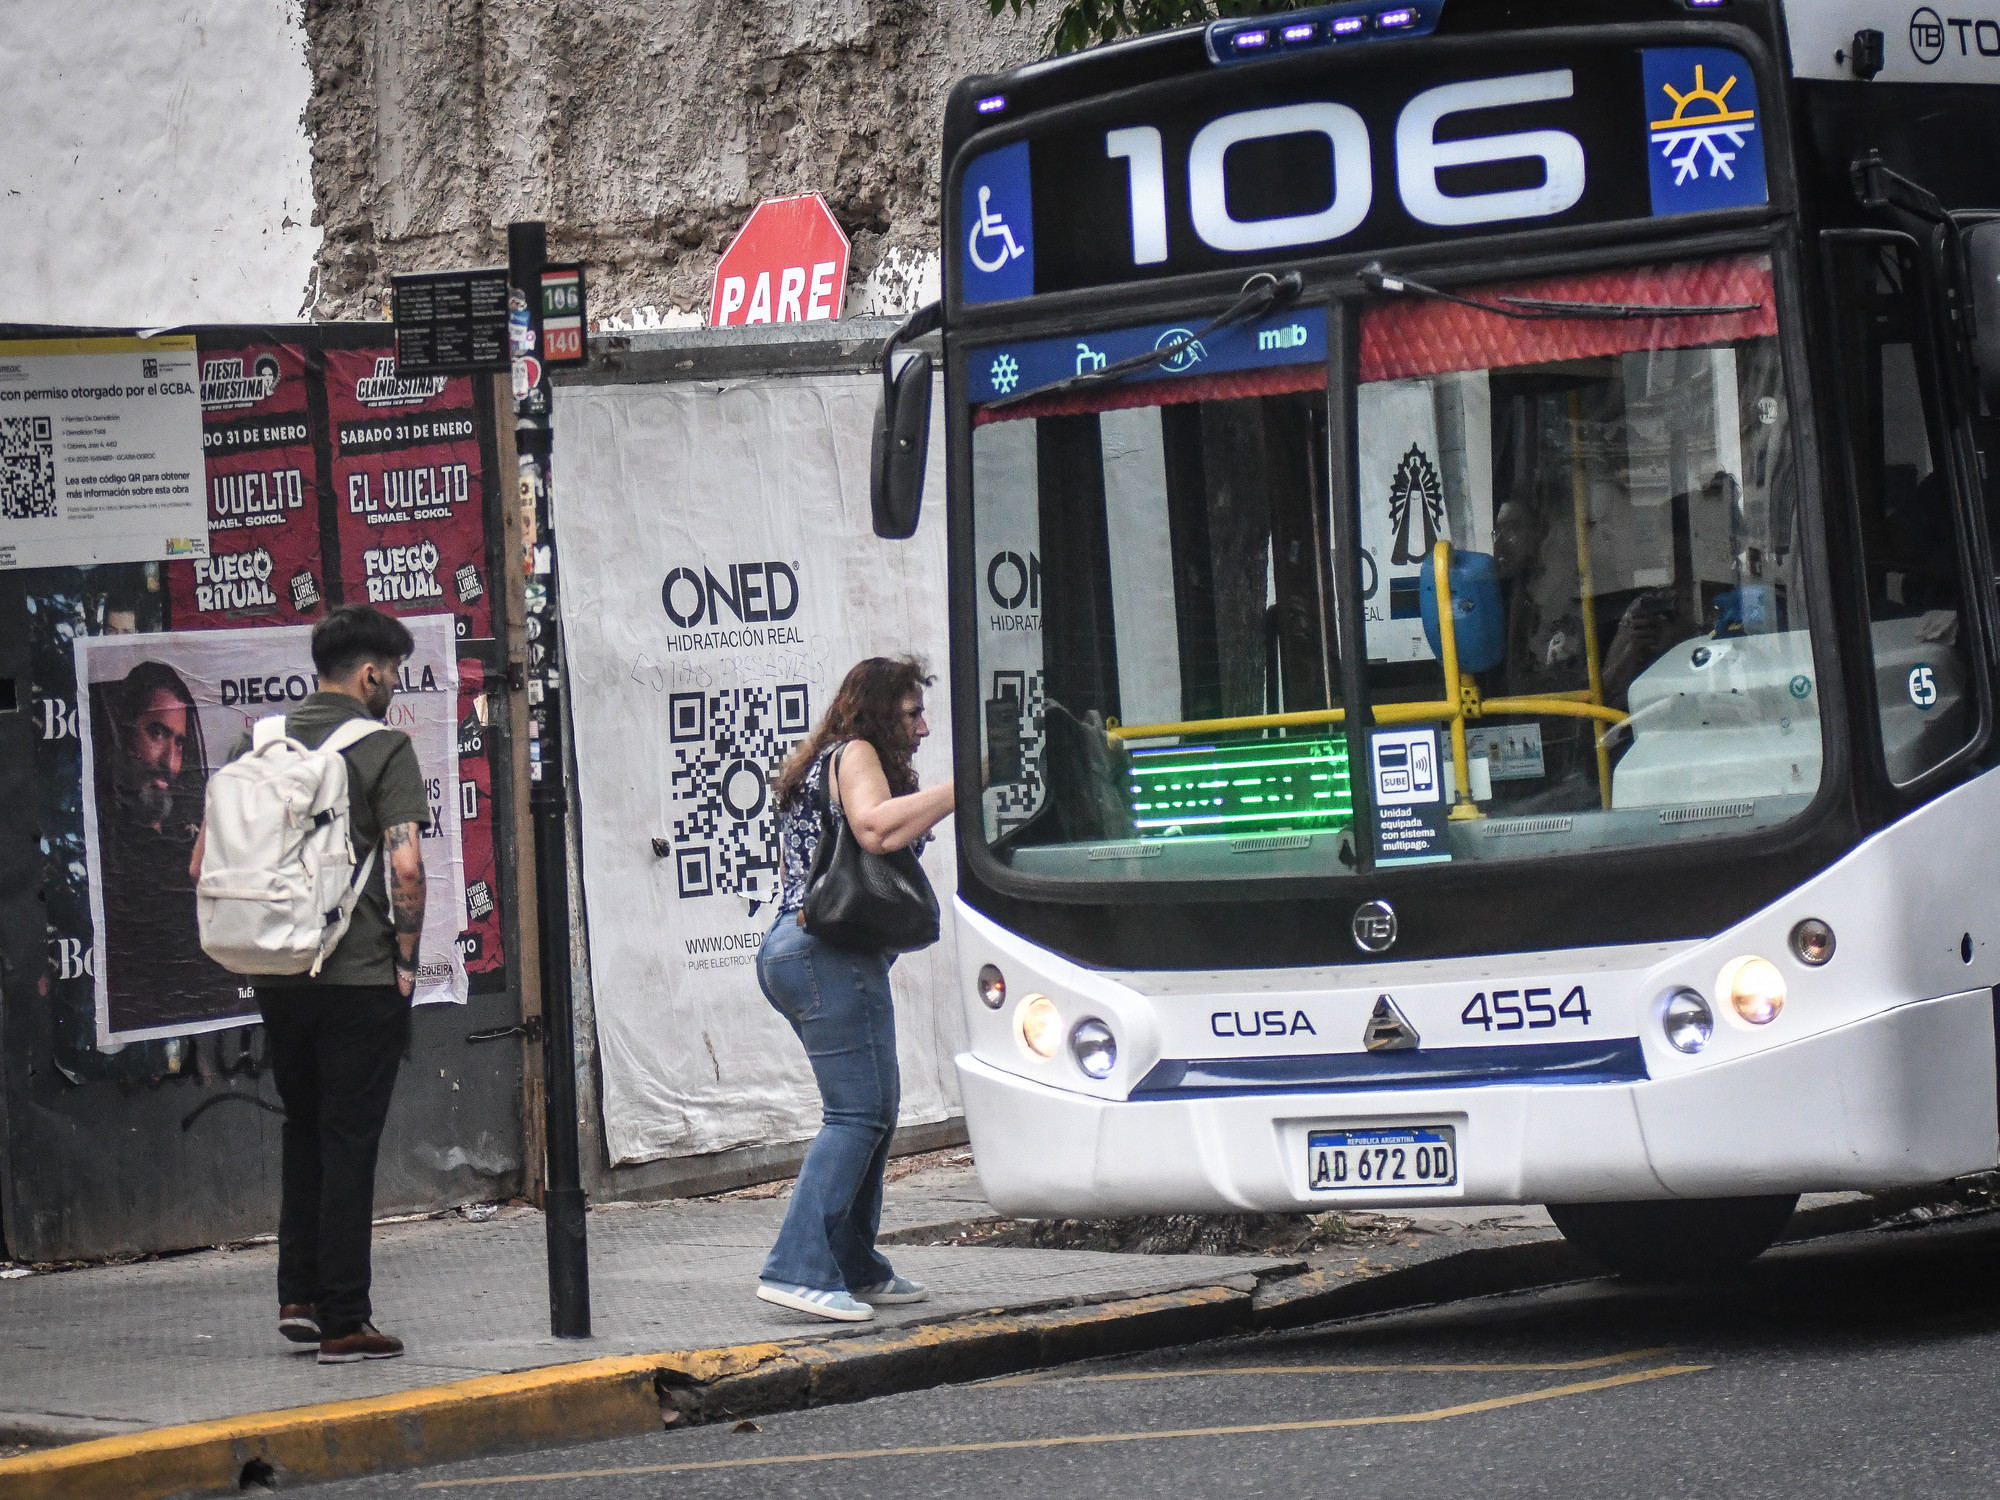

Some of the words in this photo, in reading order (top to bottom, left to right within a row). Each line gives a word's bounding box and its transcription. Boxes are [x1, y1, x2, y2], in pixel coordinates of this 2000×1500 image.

[1947, 18, 2000, 56] TO
[1107, 68, 1586, 265] 106
[545, 286, 579, 310] 106
[718, 261, 837, 326] PARE
[547, 330, 580, 353] 140
[205, 359, 242, 381] FIESTA
[375, 358, 395, 378] FIE
[1, 390, 21, 400] con
[24, 386, 69, 403] permiso
[71, 385, 123, 400] otorgado
[126, 386, 145, 399] por
[147, 383, 157, 395] el
[160, 382, 195, 395] GCBA.
[201, 379, 264, 401] ANDESTINA
[357, 378, 434, 399] CLANDESTINA
[204, 432, 222, 446] DO
[227, 430, 240, 443] 31
[244, 428, 259, 442] DE
[264, 425, 307, 441] ENERO
[341, 427, 392, 445] SABADO
[396, 425, 409, 439] 31
[413, 424, 429, 438] DE
[433, 421, 472, 437] ENERO
[66, 476, 79, 485] Lea
[81, 476, 97, 484] este
[100, 474, 127, 485] código
[128, 473, 140, 483] QR
[142, 474, 159, 483] para
[161, 472, 190, 481] obtener
[349, 475, 378, 513] EL
[383, 464, 468, 509] VUELTO
[66, 489, 82, 498] más
[84, 487, 130, 498] información
[132, 486, 153, 495] sobre
[155, 486, 170, 495] esta
[172, 485, 189, 494] obra
[214, 469, 303, 515] VUELTO
[208, 517, 242, 530] MAEL
[246, 513, 286, 526] SOKOL
[367, 511, 410, 524] ISMAEL
[414, 508, 452, 520] SOKOL
[194, 547, 273, 584] FUEGO
[364, 540, 439, 576] FUEGO
[291, 571, 312, 588] CERVEZA
[455, 565, 476, 580] CERVEZA
[458, 573, 480, 593] LIBRE
[293, 580, 316, 601] LIBRE
[667, 626, 764, 652] HIDRATACIÓN
[768, 626, 804, 645] REAL
[221, 675, 308, 706] DIEGO
[425, 778, 441, 800] HS
[1384, 777, 1408, 787] SUBE
[1380, 807, 1412, 819] Unidad
[1381, 818, 1422, 830] equipada
[1382, 831, 1399, 840] con
[1401, 828, 1436, 839] sistema
[1383, 838, 1430, 852] multipago.
[466, 881, 487, 897] CERVEZA
[469, 890, 490, 909] LIBRE
[685, 931, 766, 955] WWW.ONED
[417, 963, 453, 978] SEQUEIRA
[688, 958, 709, 971] PURE
[710, 954, 757, 969] ELECTROLYT
[237, 986, 254, 998] TuE
[1461, 985, 1592, 1032] 4554
[1211, 1010, 1317, 1037] CUSA
[1381, 1136, 1415, 1144] ARGENTINA
[1317, 1151, 1347, 1183] AD
[1358, 1148, 1406, 1181] 672
